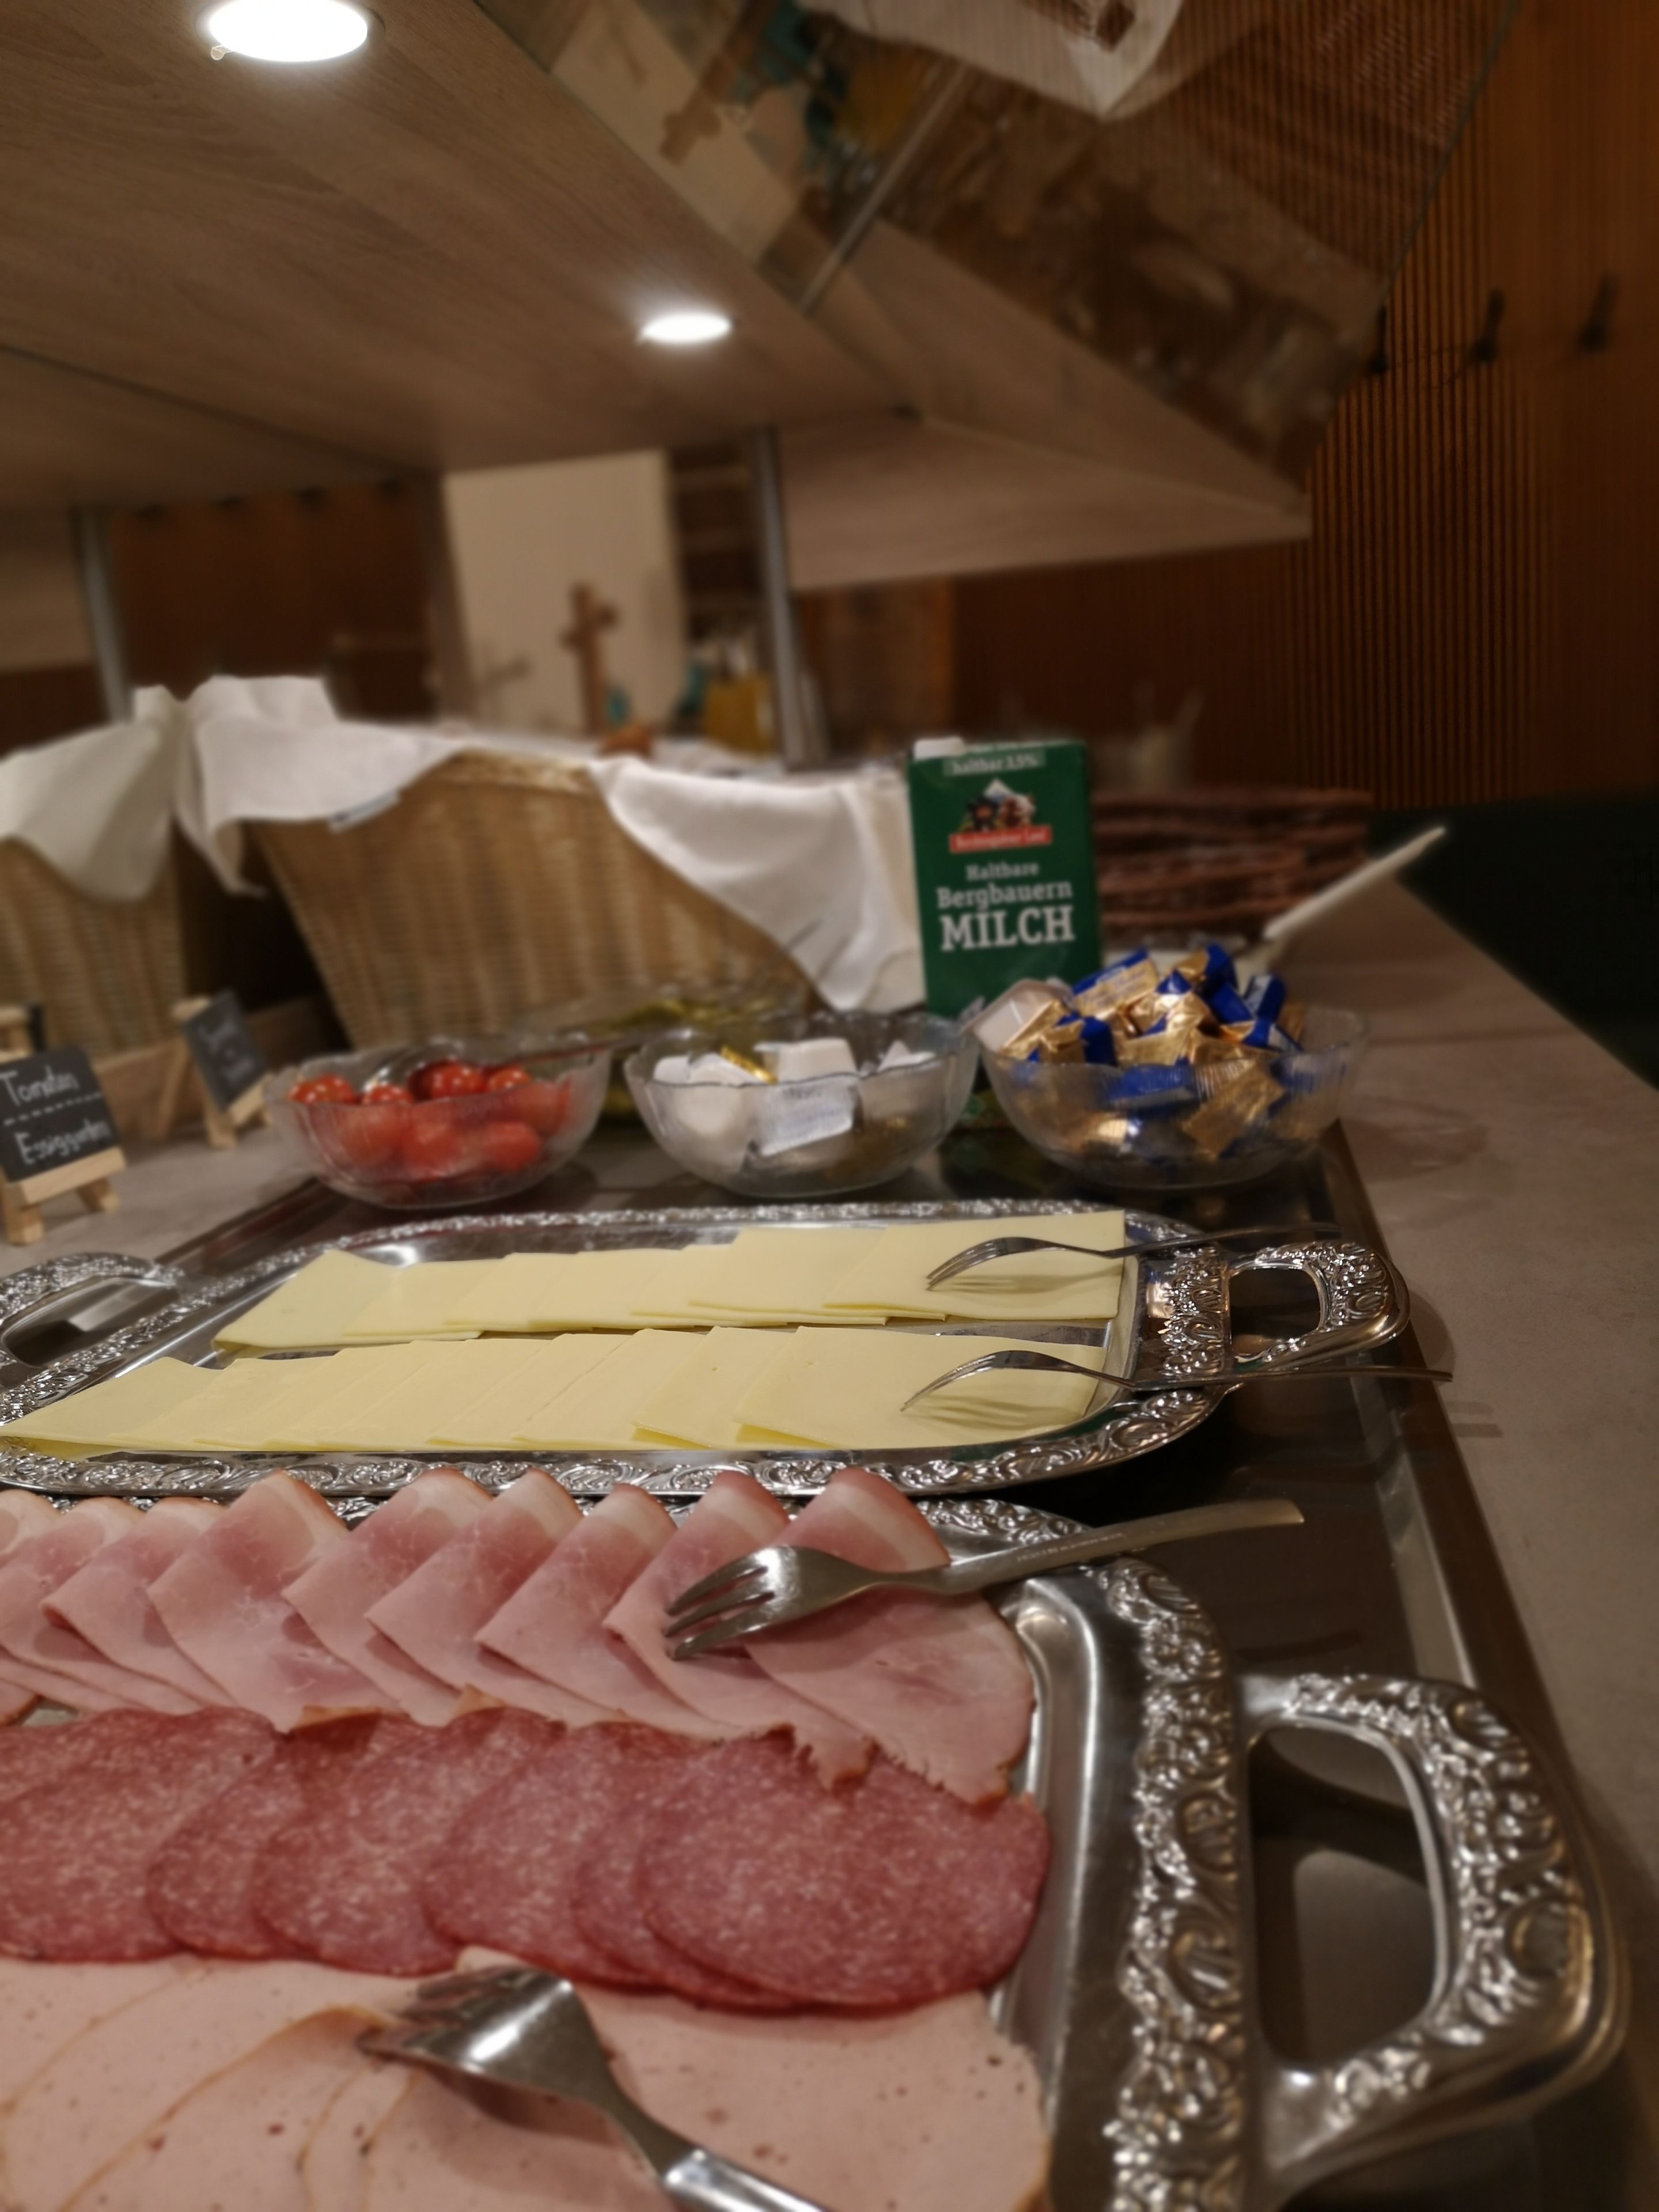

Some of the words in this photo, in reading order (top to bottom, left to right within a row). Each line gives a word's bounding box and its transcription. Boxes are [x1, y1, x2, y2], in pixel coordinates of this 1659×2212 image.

[966, 862, 1039, 881] Haltbare
[936, 881, 1073, 910] Bergbauern
[941, 905, 1075, 951] MILCH
